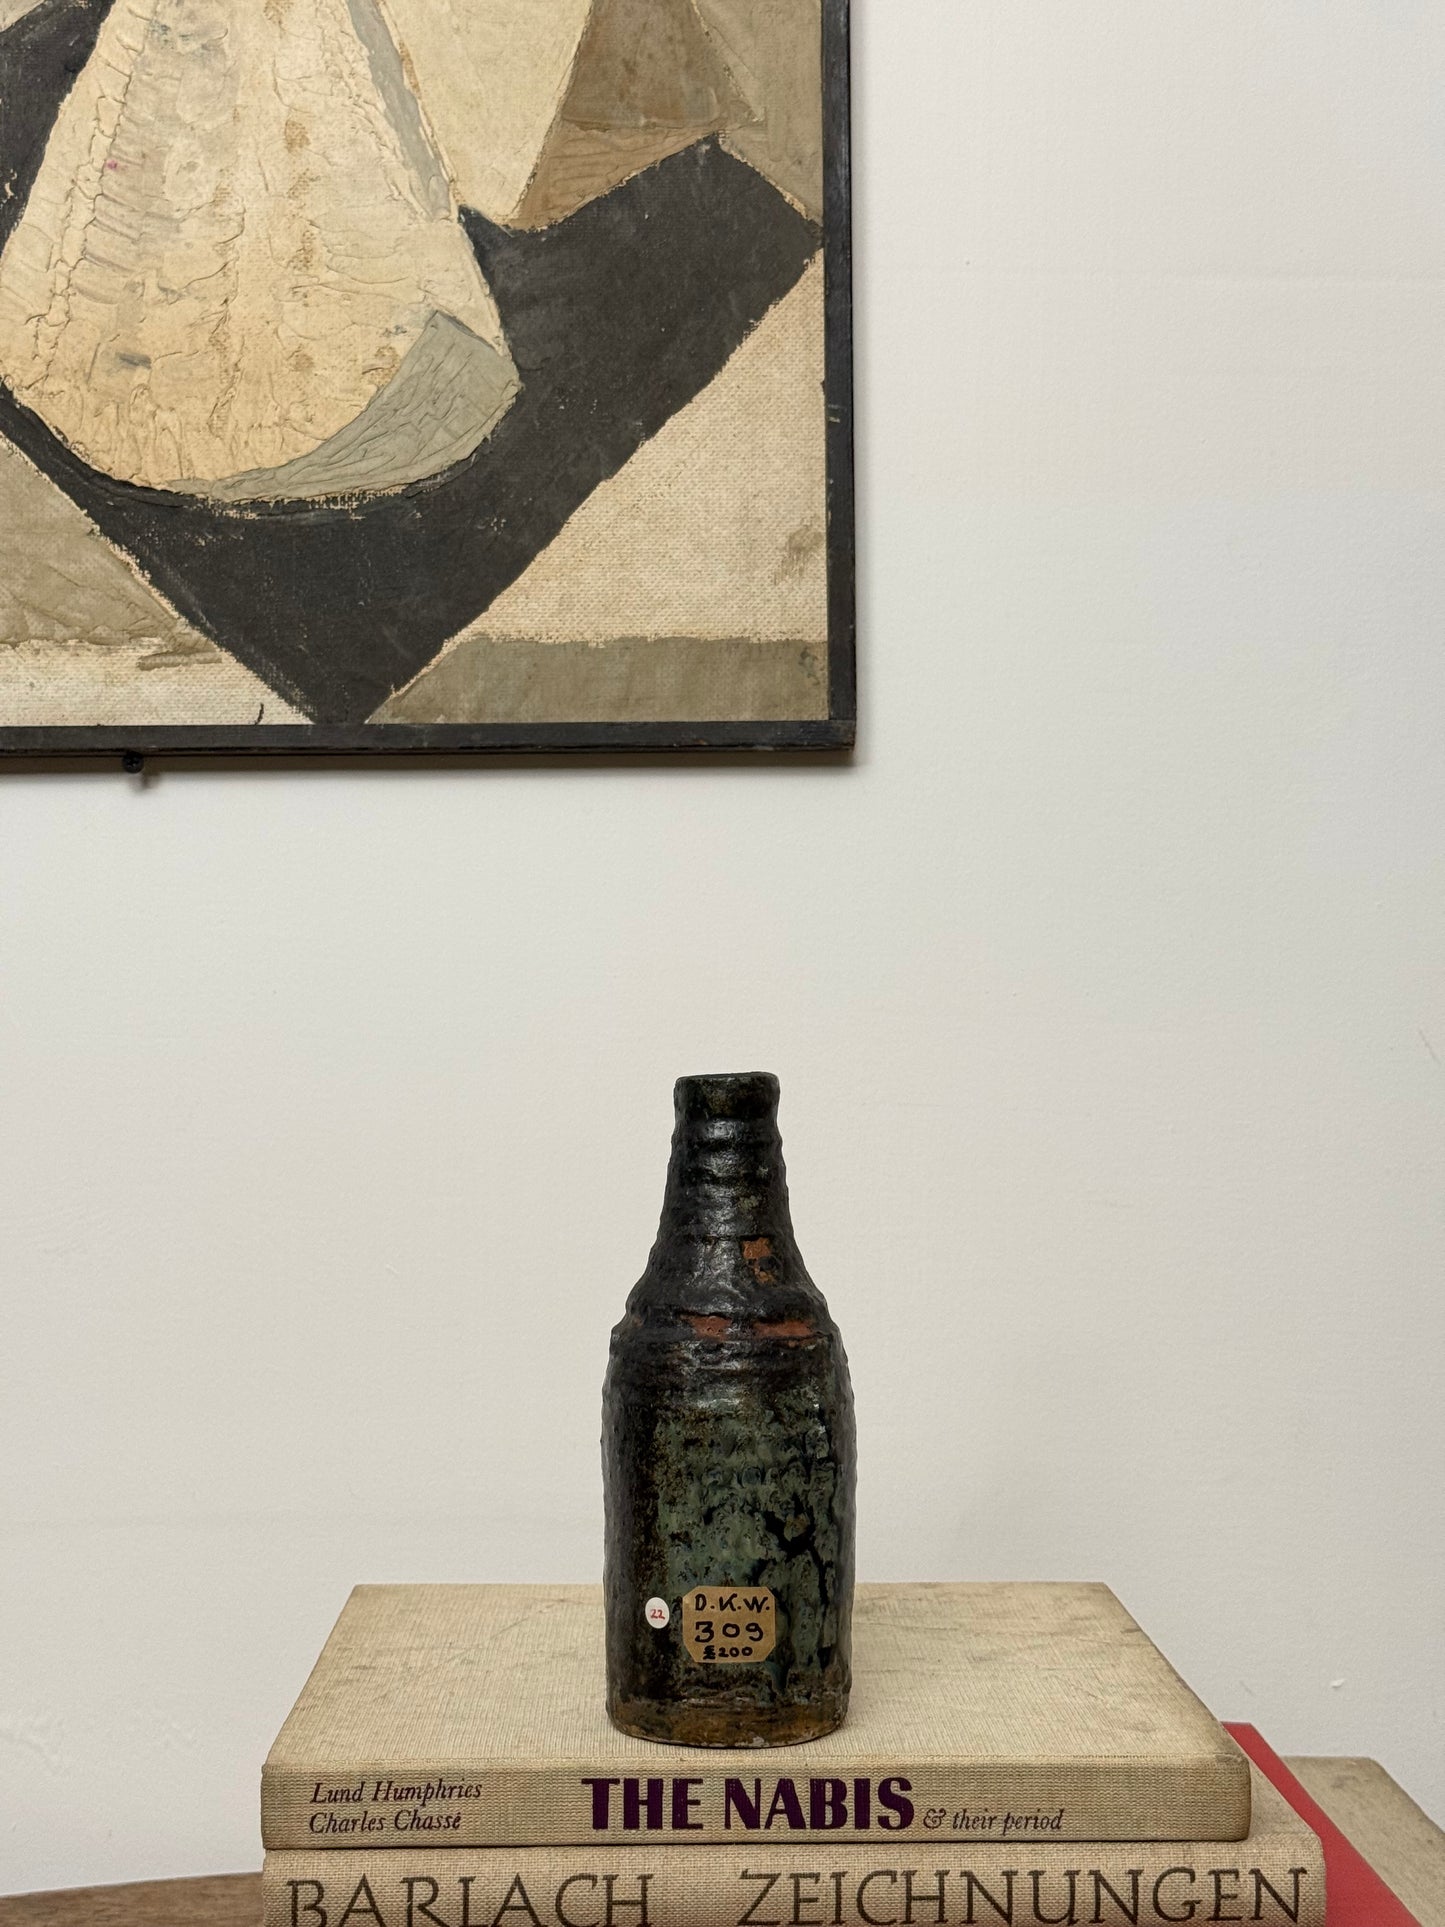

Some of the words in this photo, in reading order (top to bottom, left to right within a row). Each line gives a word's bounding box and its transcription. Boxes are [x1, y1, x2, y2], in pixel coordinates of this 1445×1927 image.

[651, 1609, 665, 1620] 22
[695, 1593, 770, 1613] D.K.W.
[695, 1621, 764, 1643] 309
[703, 1645, 753, 1660] £200
[310, 1781, 365, 1804] Lund
[372, 1778, 482, 1807] Humphries
[582, 1777, 704, 1831] THE
[723, 1776, 914, 1831] NABIS
[923, 1807, 947, 1830] &
[952, 1808, 997, 1831] their
[1001, 1807, 1064, 1836] period
[309, 1810, 385, 1834] Charles
[394, 1808, 462, 1832] Chassé
[286, 1872, 653, 1927] BARLACH
[737, 1867, 1308, 1927] ZEICHNUNGEN
